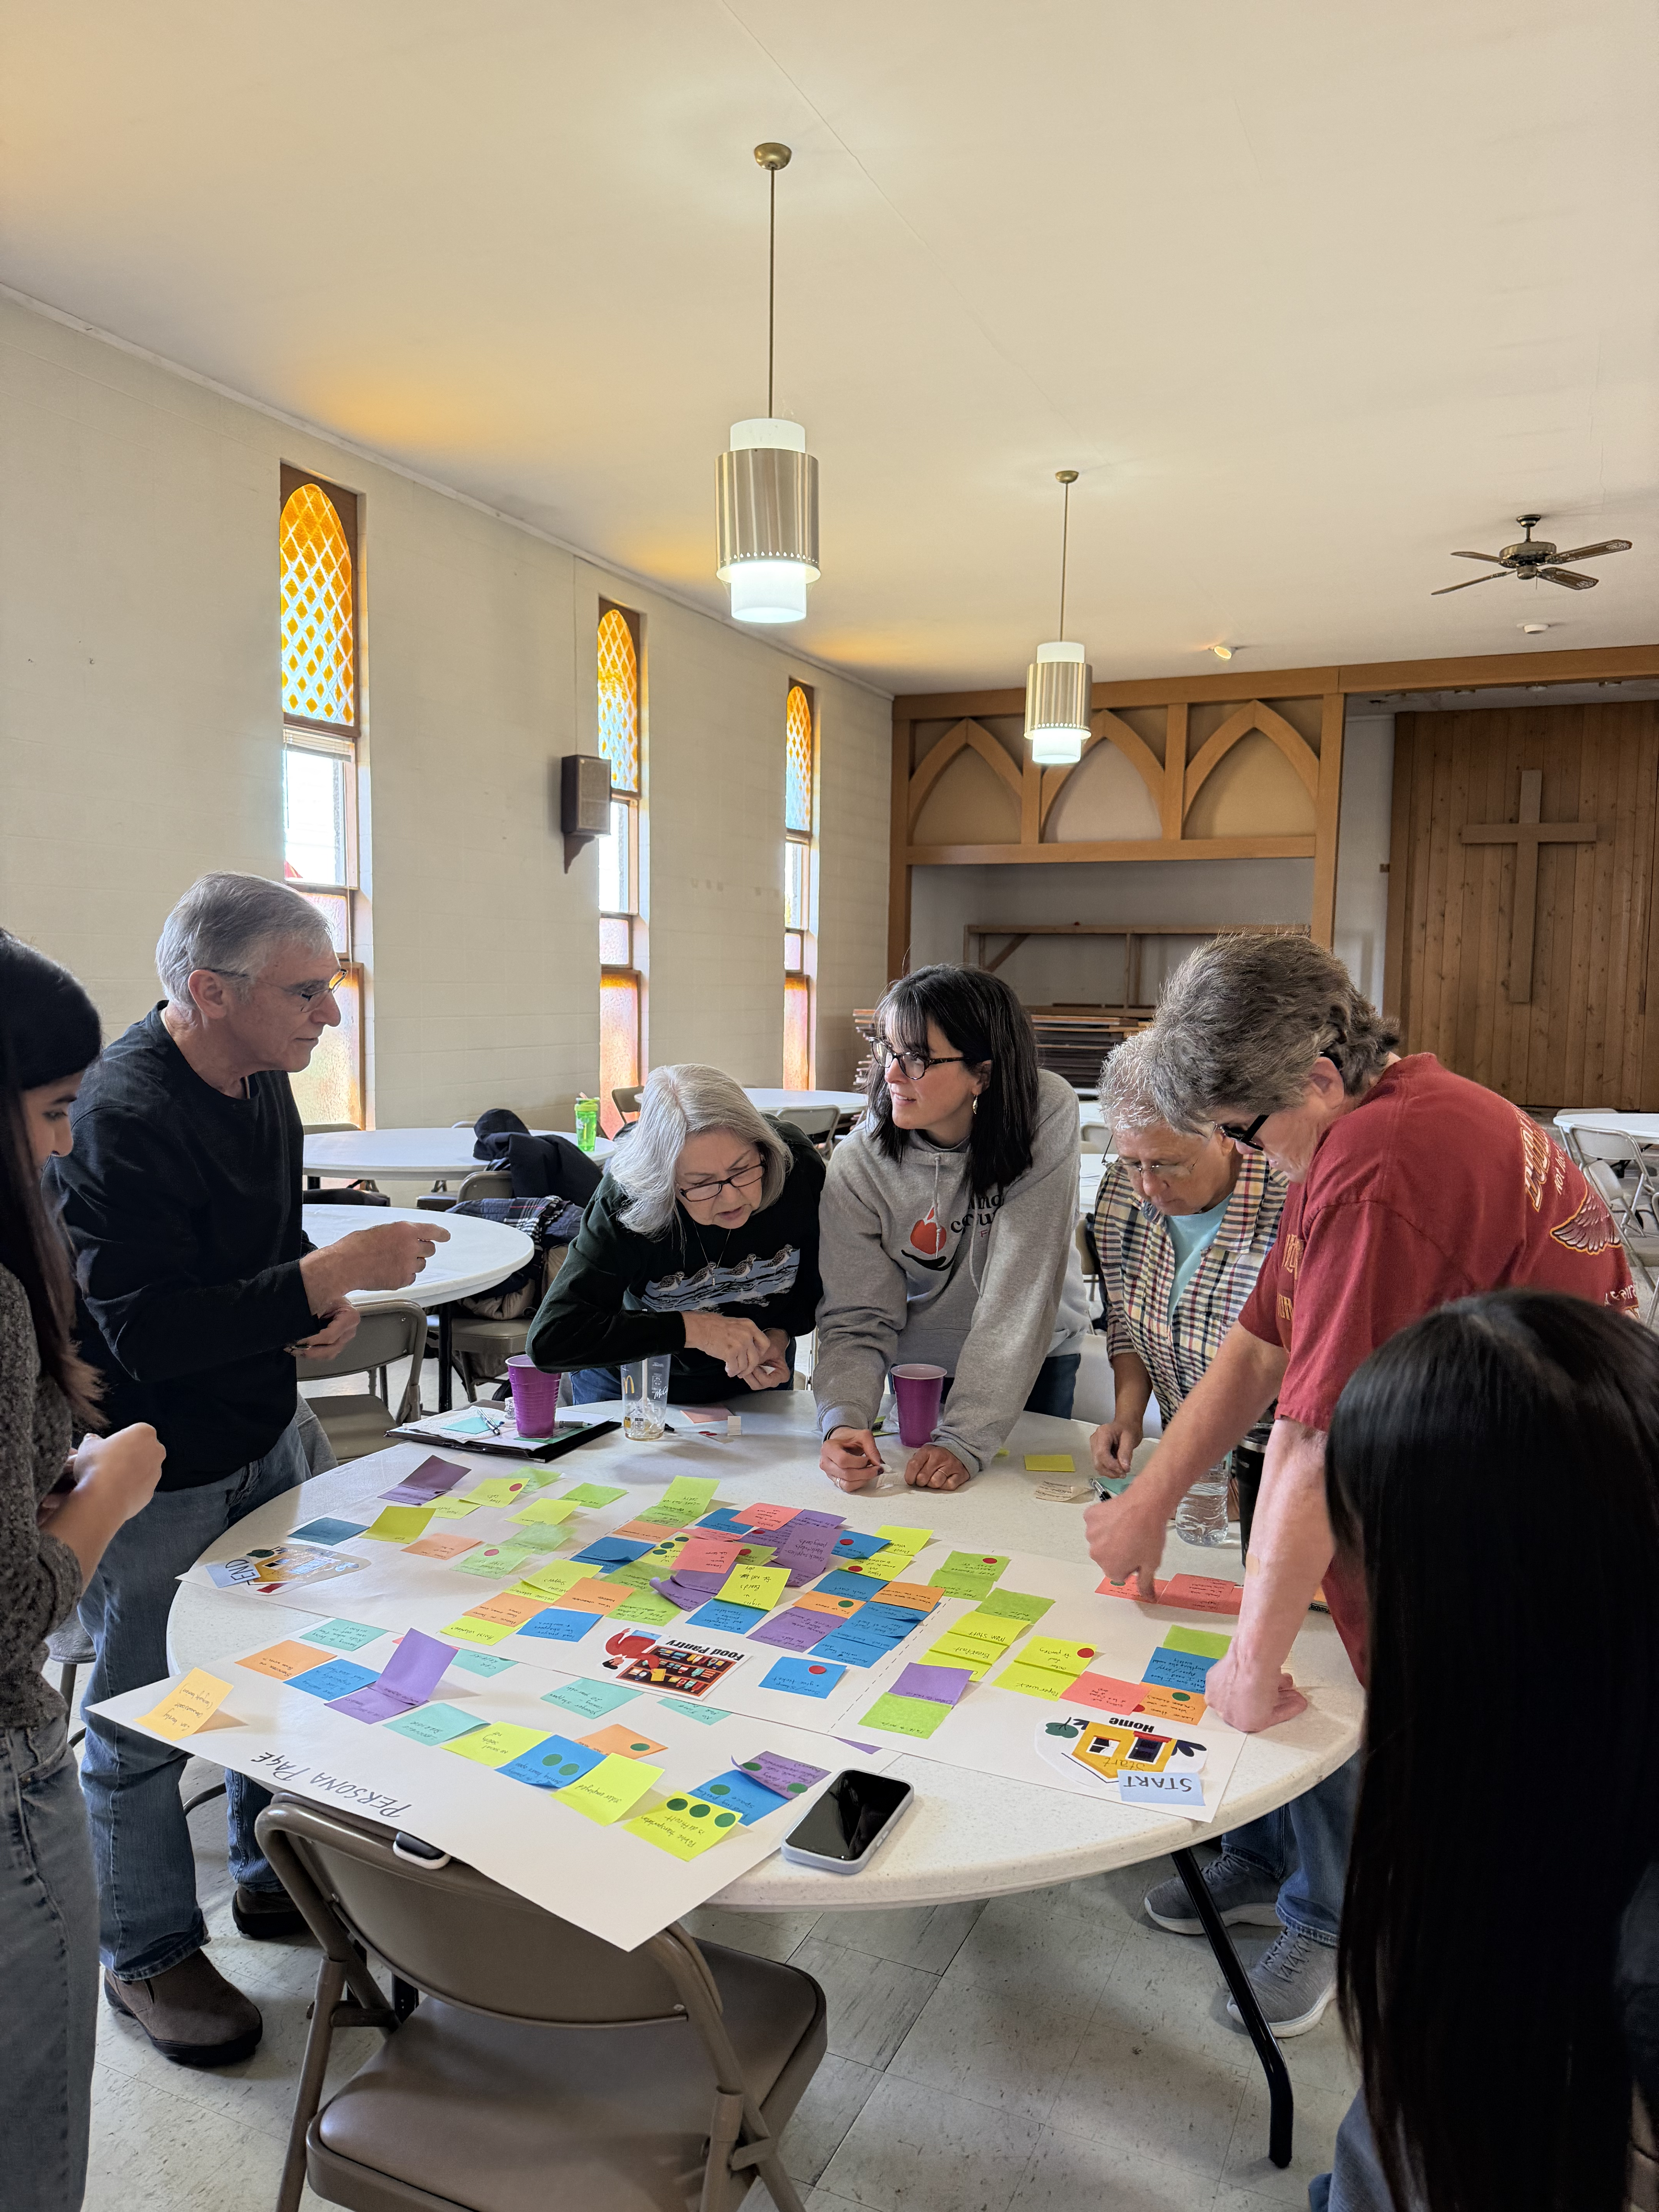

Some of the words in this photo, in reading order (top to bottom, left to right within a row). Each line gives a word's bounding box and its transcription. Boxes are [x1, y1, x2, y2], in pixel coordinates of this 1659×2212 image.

[224, 1558, 256, 1582] END
[666, 1640, 710, 1654] Pantry
[955, 1647, 990, 1659] Breakfast
[710, 1649, 745, 1661] Food
[1109, 1717, 1154, 1731] Home
[251, 1752, 310, 1781] PAGE
[1104, 1757, 1145, 1771] Start
[1123, 1776, 1192, 1792] START
[310, 1772, 412, 1817] PERSONA
